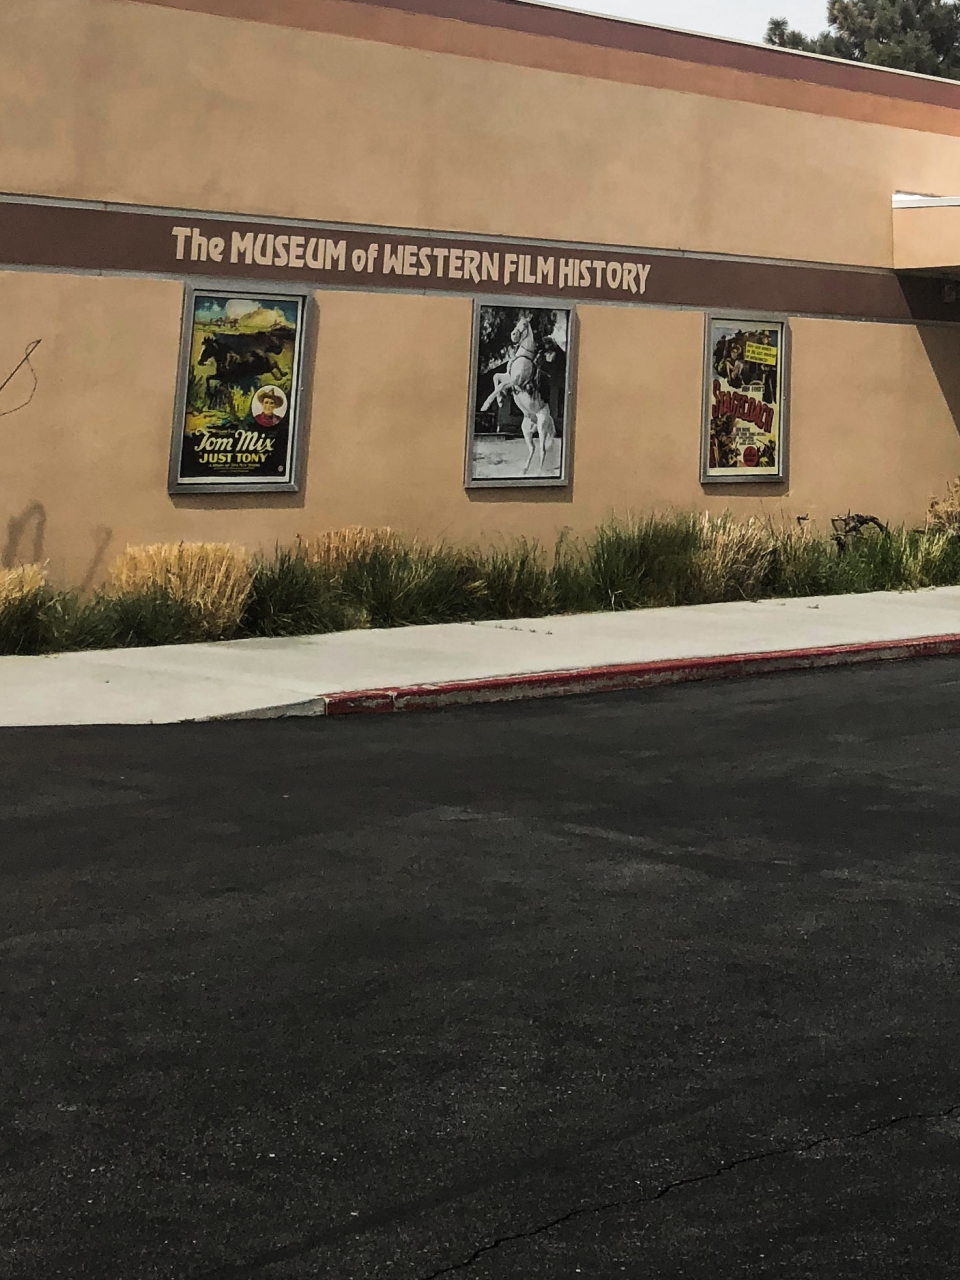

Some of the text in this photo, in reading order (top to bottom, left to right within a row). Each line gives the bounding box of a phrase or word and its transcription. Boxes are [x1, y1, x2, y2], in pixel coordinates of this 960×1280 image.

[171, 226, 651, 294] The MUSEUM of WESTERN FILM HISTORY
[711, 379, 775, 434] STAGECOACH
[194, 427, 276, 453] Tom Mix
